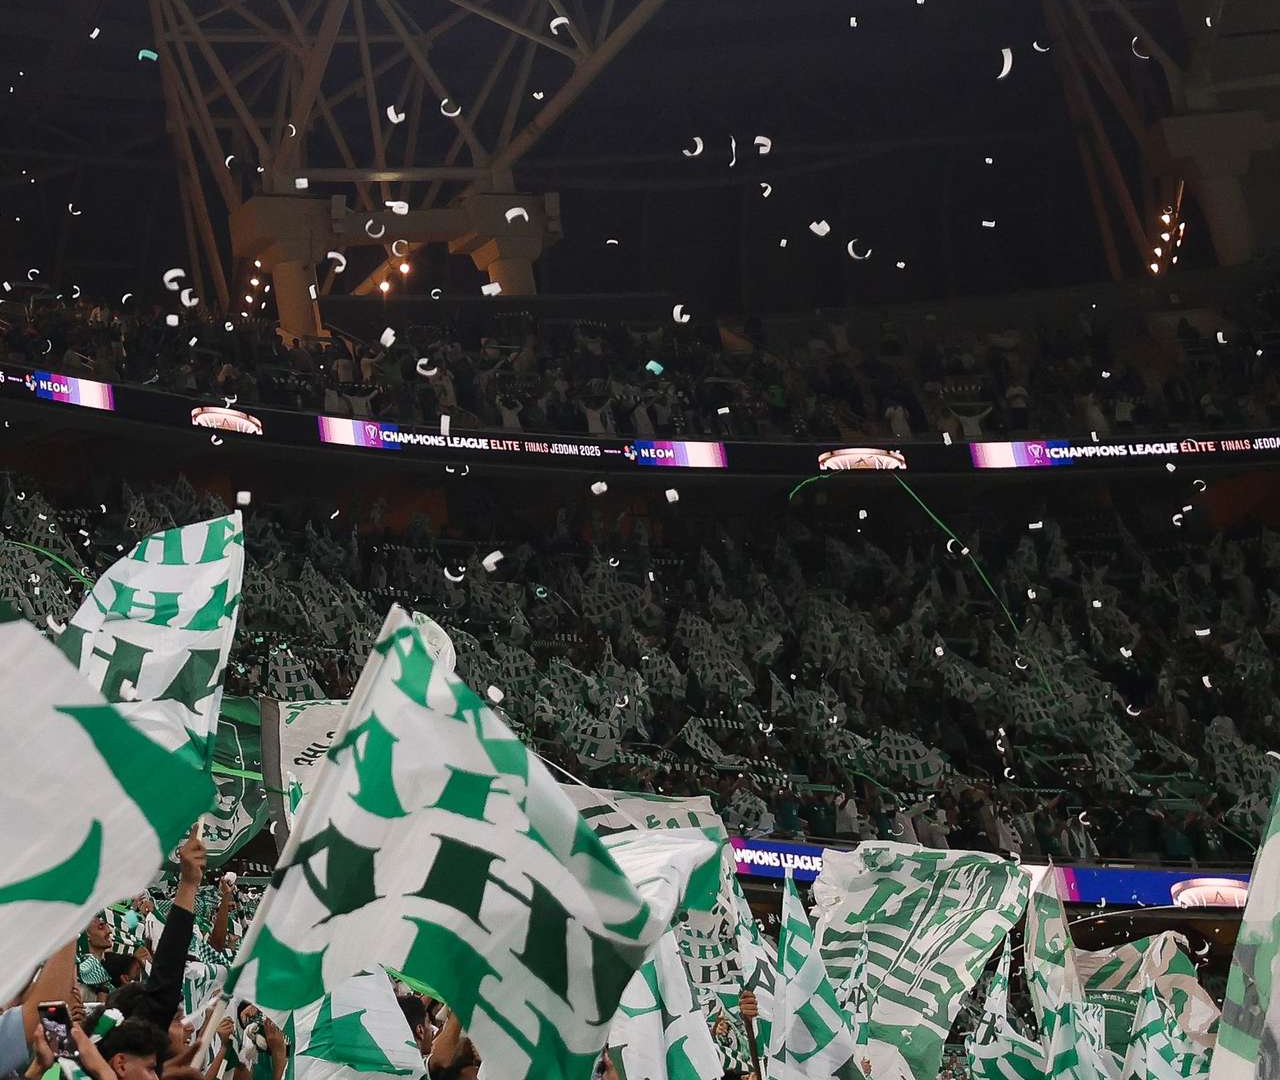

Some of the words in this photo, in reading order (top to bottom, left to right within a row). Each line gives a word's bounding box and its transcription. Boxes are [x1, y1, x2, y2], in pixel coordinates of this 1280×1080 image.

[40, 380, 69, 394] NEOM
[383, 429, 445, 447] CHAMPIONS
[446, 436, 490, 450] LEAGUE
[490, 439, 521, 452] ELITE
[524, 441, 549, 453] FINALS
[550, 442, 579, 456] JEDDAH
[580, 445, 601, 457] 2025
[1049, 445, 1128, 459] CHAMPIONS
[1128, 442, 1179, 456] LEAGUE
[1180, 441, 1216, 453] ELITE
[1221, 439, 1251, 452] FINALS
[641, 447, 675, 459] NEOM
[781, 853, 823, 872] LEAGUE
